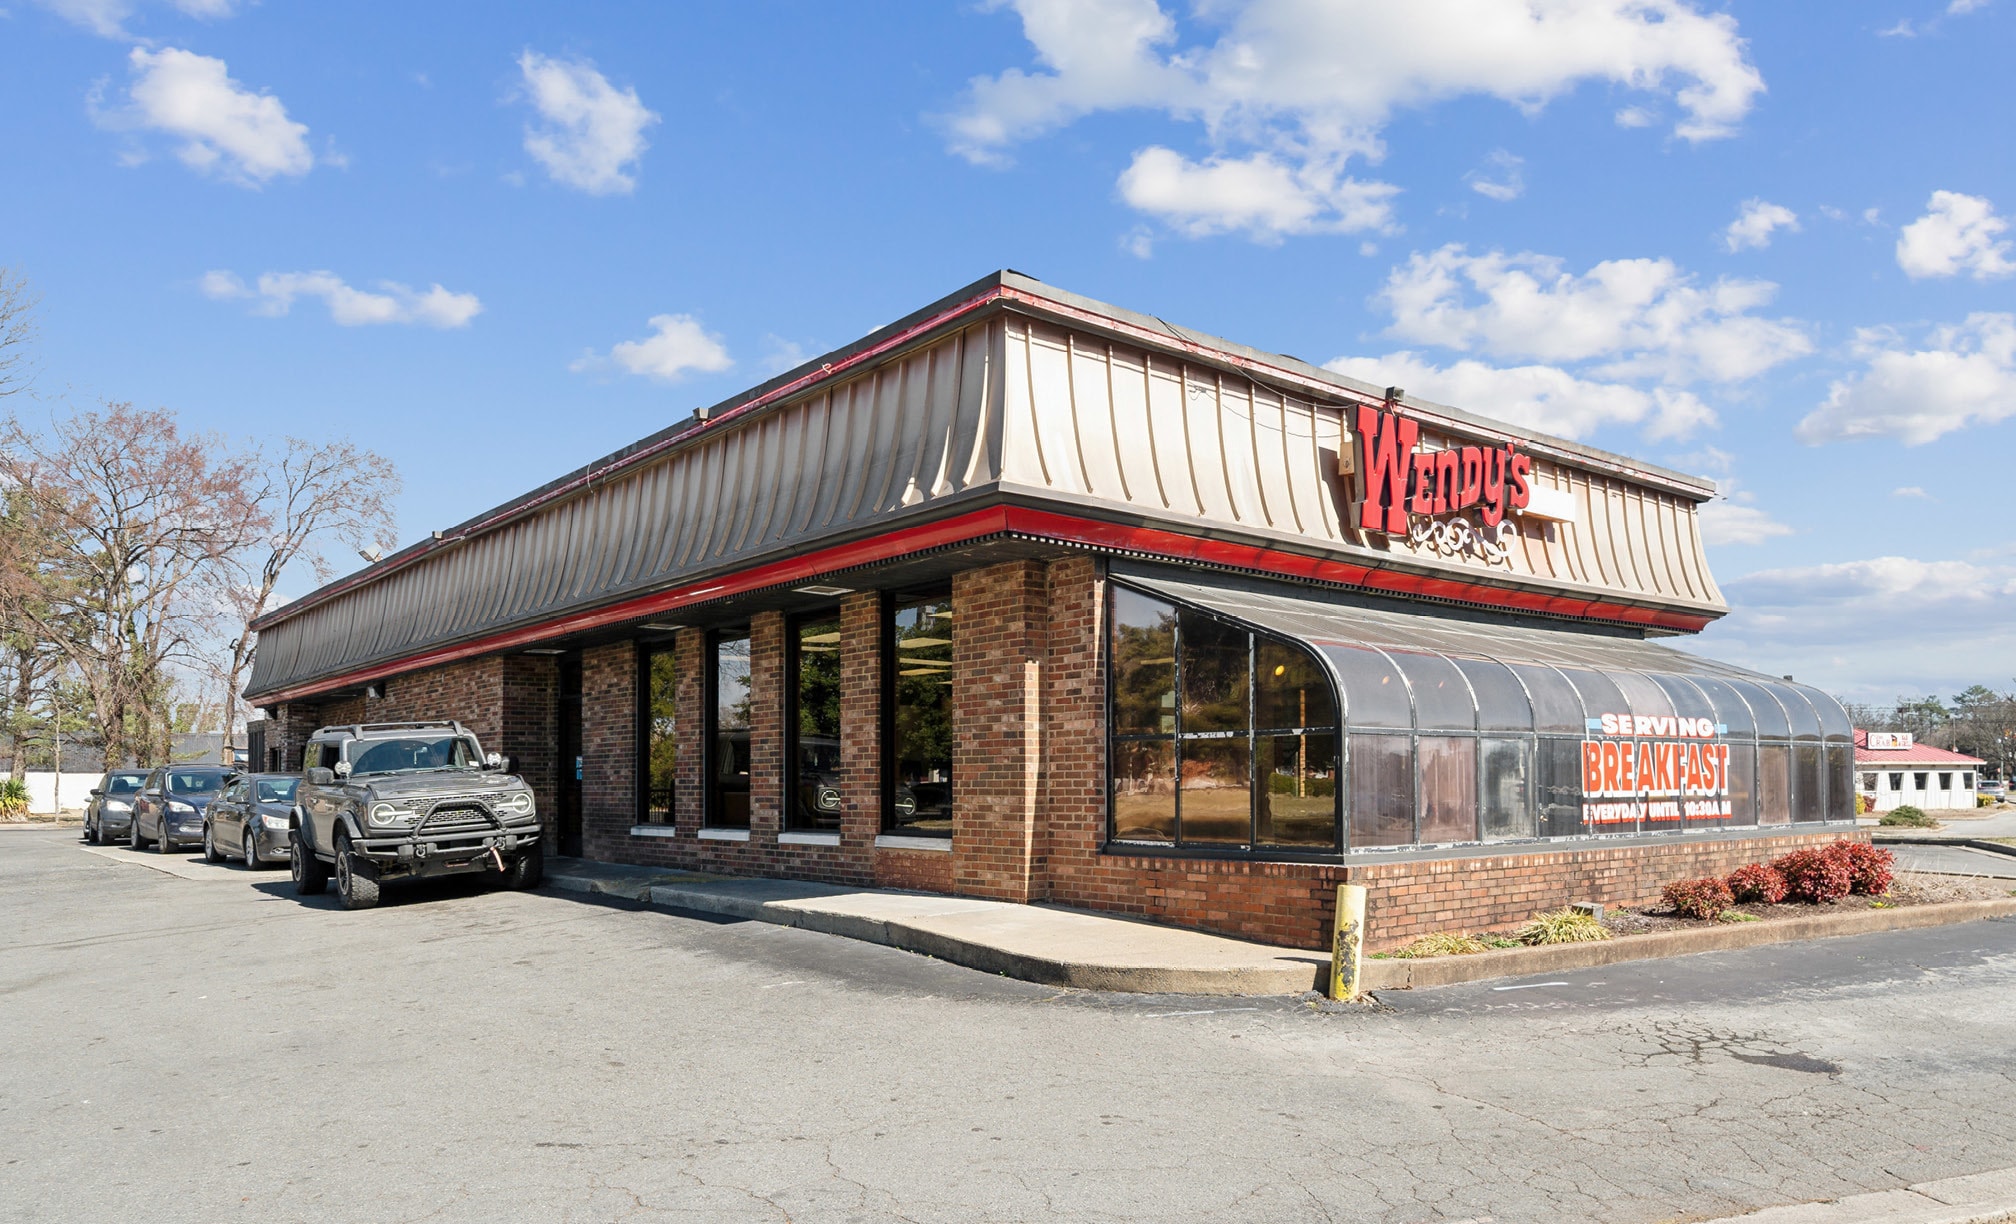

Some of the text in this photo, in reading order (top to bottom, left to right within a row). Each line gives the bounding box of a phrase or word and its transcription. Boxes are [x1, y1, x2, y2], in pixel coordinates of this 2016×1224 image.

[1601, 713, 1715, 738] SERVING
[1581, 740, 1730, 798] BREAKFAST
[1582, 802, 1647, 825] EVERYDAY
[1648, 801, 1681, 821] UNTIL
